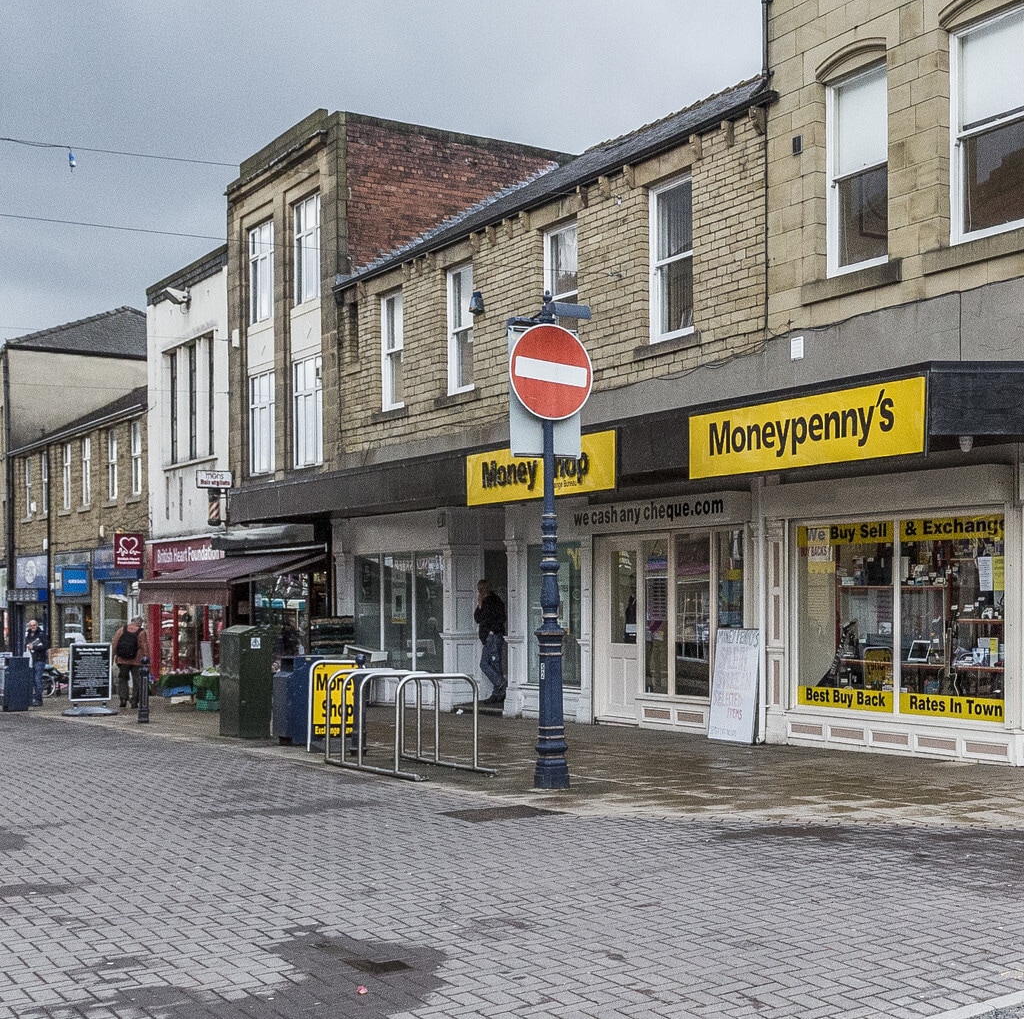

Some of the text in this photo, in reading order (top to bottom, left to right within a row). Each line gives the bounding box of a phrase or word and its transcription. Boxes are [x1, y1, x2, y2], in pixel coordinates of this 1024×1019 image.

[708, 388, 895, 458] Moneypenny's
[481, 459, 538, 491] Money
[573, 498, 724, 526] we cash any cheque.com
[806, 527, 826, 541] We
[830, 526, 855, 542] Buy
[861, 523, 887, 538] Sell
[905, 521, 917, 535] &
[806, 687, 1003, 717] Best Buy Back Rates In Town
